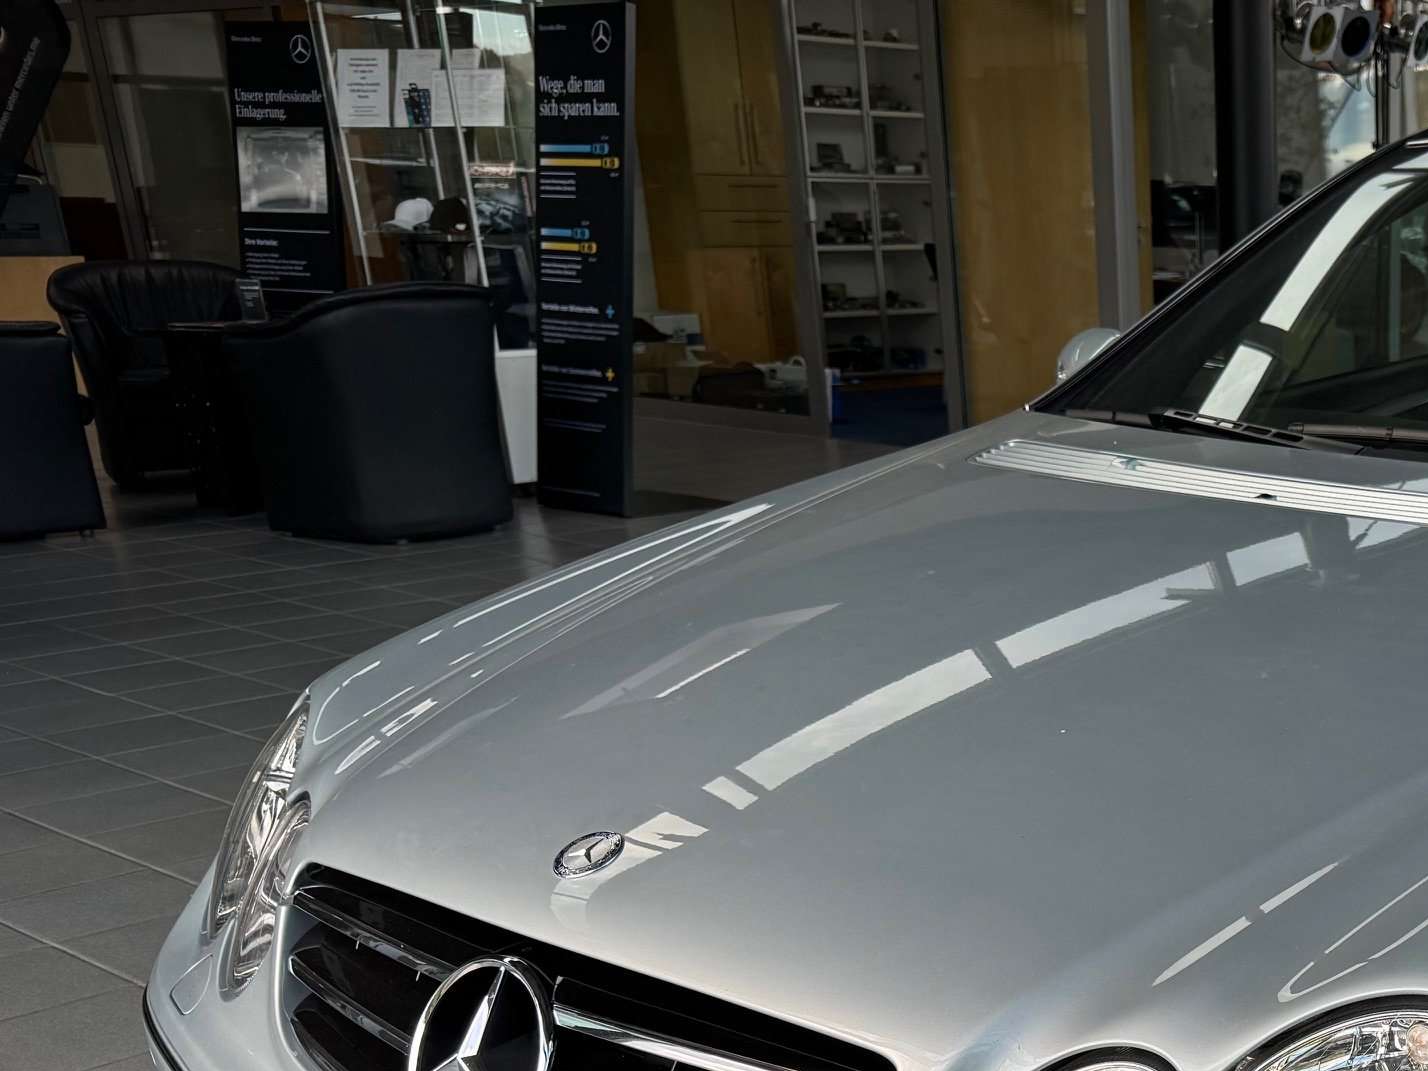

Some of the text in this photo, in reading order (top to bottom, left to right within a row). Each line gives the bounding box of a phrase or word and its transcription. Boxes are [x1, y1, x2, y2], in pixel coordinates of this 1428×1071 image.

[233, 88, 322, 105] Unsere professionelle
[538, 75, 605, 97] Wege, die man
[538, 98, 621, 120] sich sparen kann.
